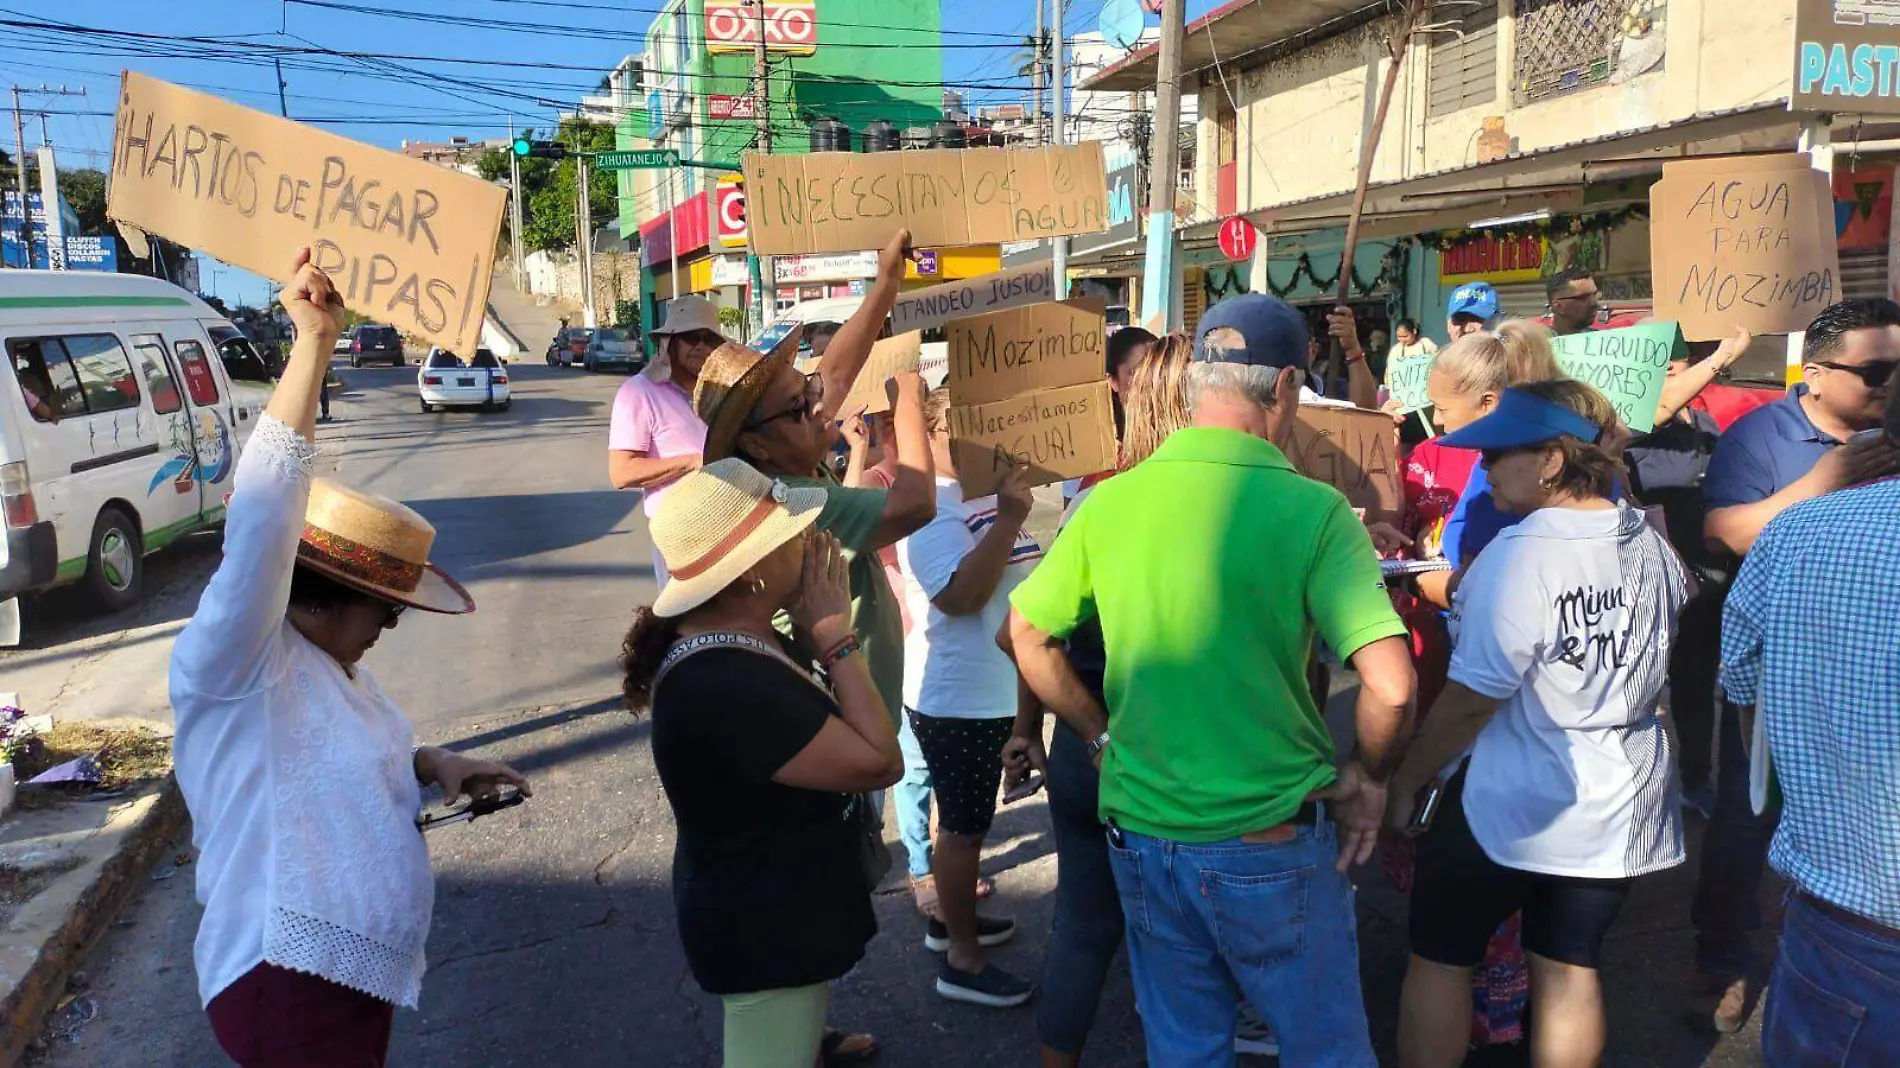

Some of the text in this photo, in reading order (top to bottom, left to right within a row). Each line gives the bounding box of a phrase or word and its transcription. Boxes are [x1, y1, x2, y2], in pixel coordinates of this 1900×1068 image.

[709, 7, 812, 42] OXXO
[1800, 42, 1900, 97] PAST
[598, 153, 663, 167] ZIHUATANEJO
[273, 173, 312, 221] DE
[313, 156, 440, 256] PAGAR
[1685, 181, 1790, 221] AGUA
[1706, 224, 1792, 253] PARA
[313, 239, 480, 347] PIPAS!
[986, 267, 1051, 306] JUSTO!
[1584, 336, 1668, 368] LIQUIDO
[1562, 360, 1653, 400] MAYORES
[992, 421, 1076, 472] AGUA!
[1554, 585, 1627, 634] Minn
[696, 632, 738, 646] POLO
[1558, 629, 1632, 675] & Mi
